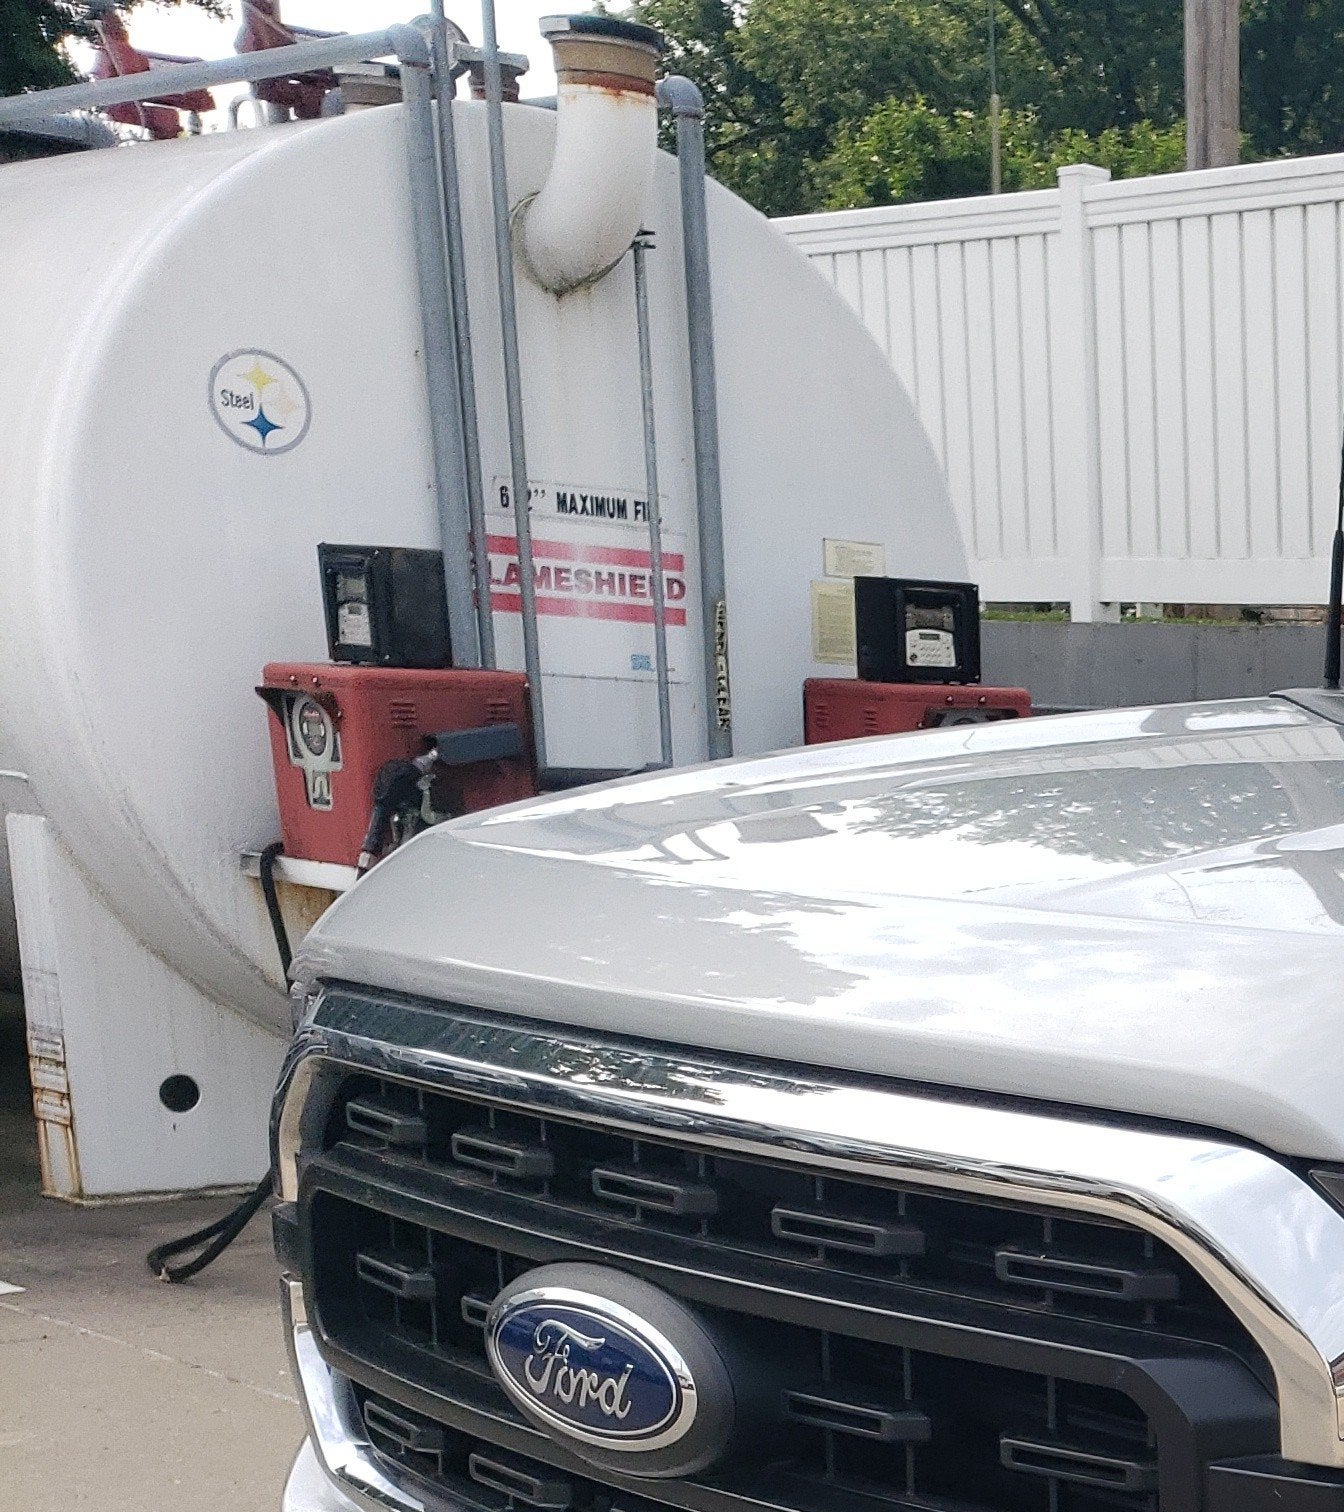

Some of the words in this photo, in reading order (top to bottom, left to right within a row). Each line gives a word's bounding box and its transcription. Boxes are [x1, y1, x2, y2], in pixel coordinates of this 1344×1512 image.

[220, 388, 255, 410] Steel
[556, 491, 627, 519] MAXIMUM
[633, 499, 663, 525] FI
[470, 558, 686, 601] LAMESHIED
[525, 1319, 635, 1420] Ford
